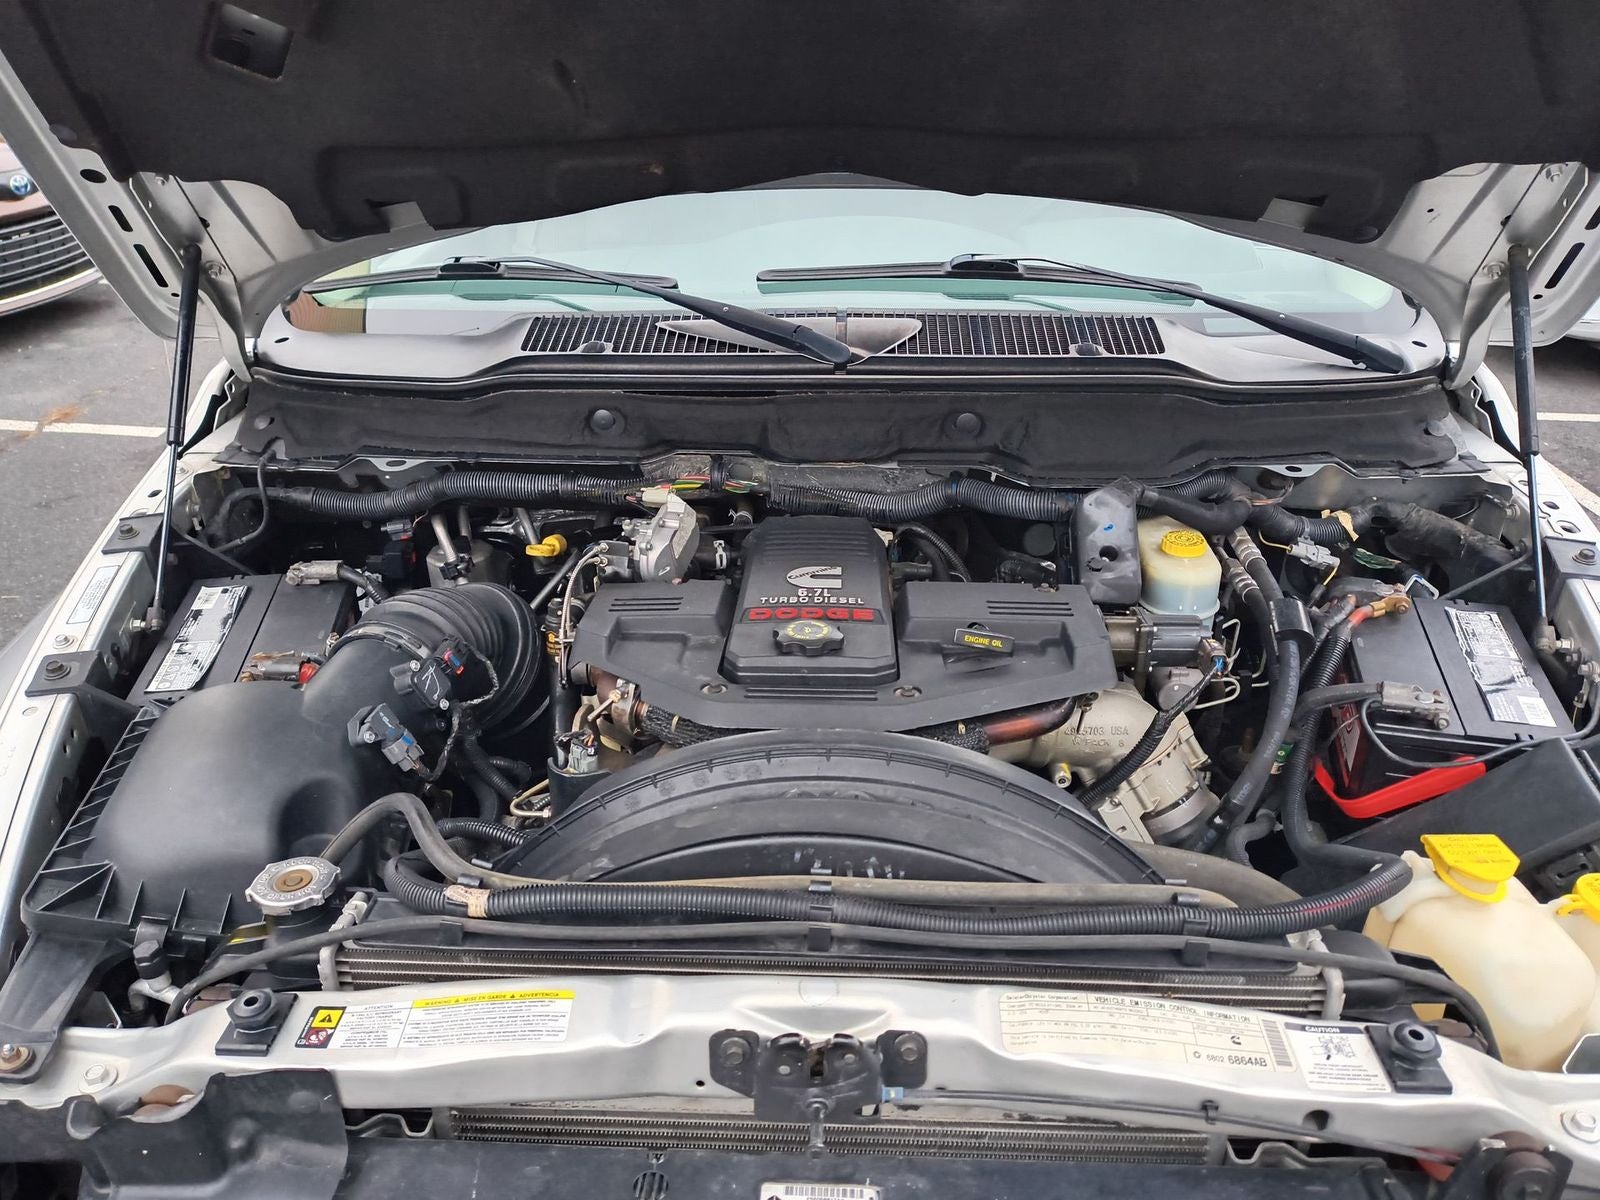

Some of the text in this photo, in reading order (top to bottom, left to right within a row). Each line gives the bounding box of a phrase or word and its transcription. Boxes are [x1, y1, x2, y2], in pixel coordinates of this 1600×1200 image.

[798, 588, 831, 597] 6.7L
[760, 597, 865, 605] TURBO DIESEL
[748, 607, 875, 621] DODGE
[964, 634, 1003, 648] ENGINE OIL
[1110, 725, 1129, 736] USA
[1094, 996, 1126, 1005] VEHICLE
[1129, 998, 1166, 1009] EMISSION
[1168, 1004, 1197, 1014] CONTROL
[1203, 1010, 1251, 1023] INFORMATION
[1305, 1025, 1340, 1033] CAUTION
[1227, 1055, 1268, 1067] 6864AB
